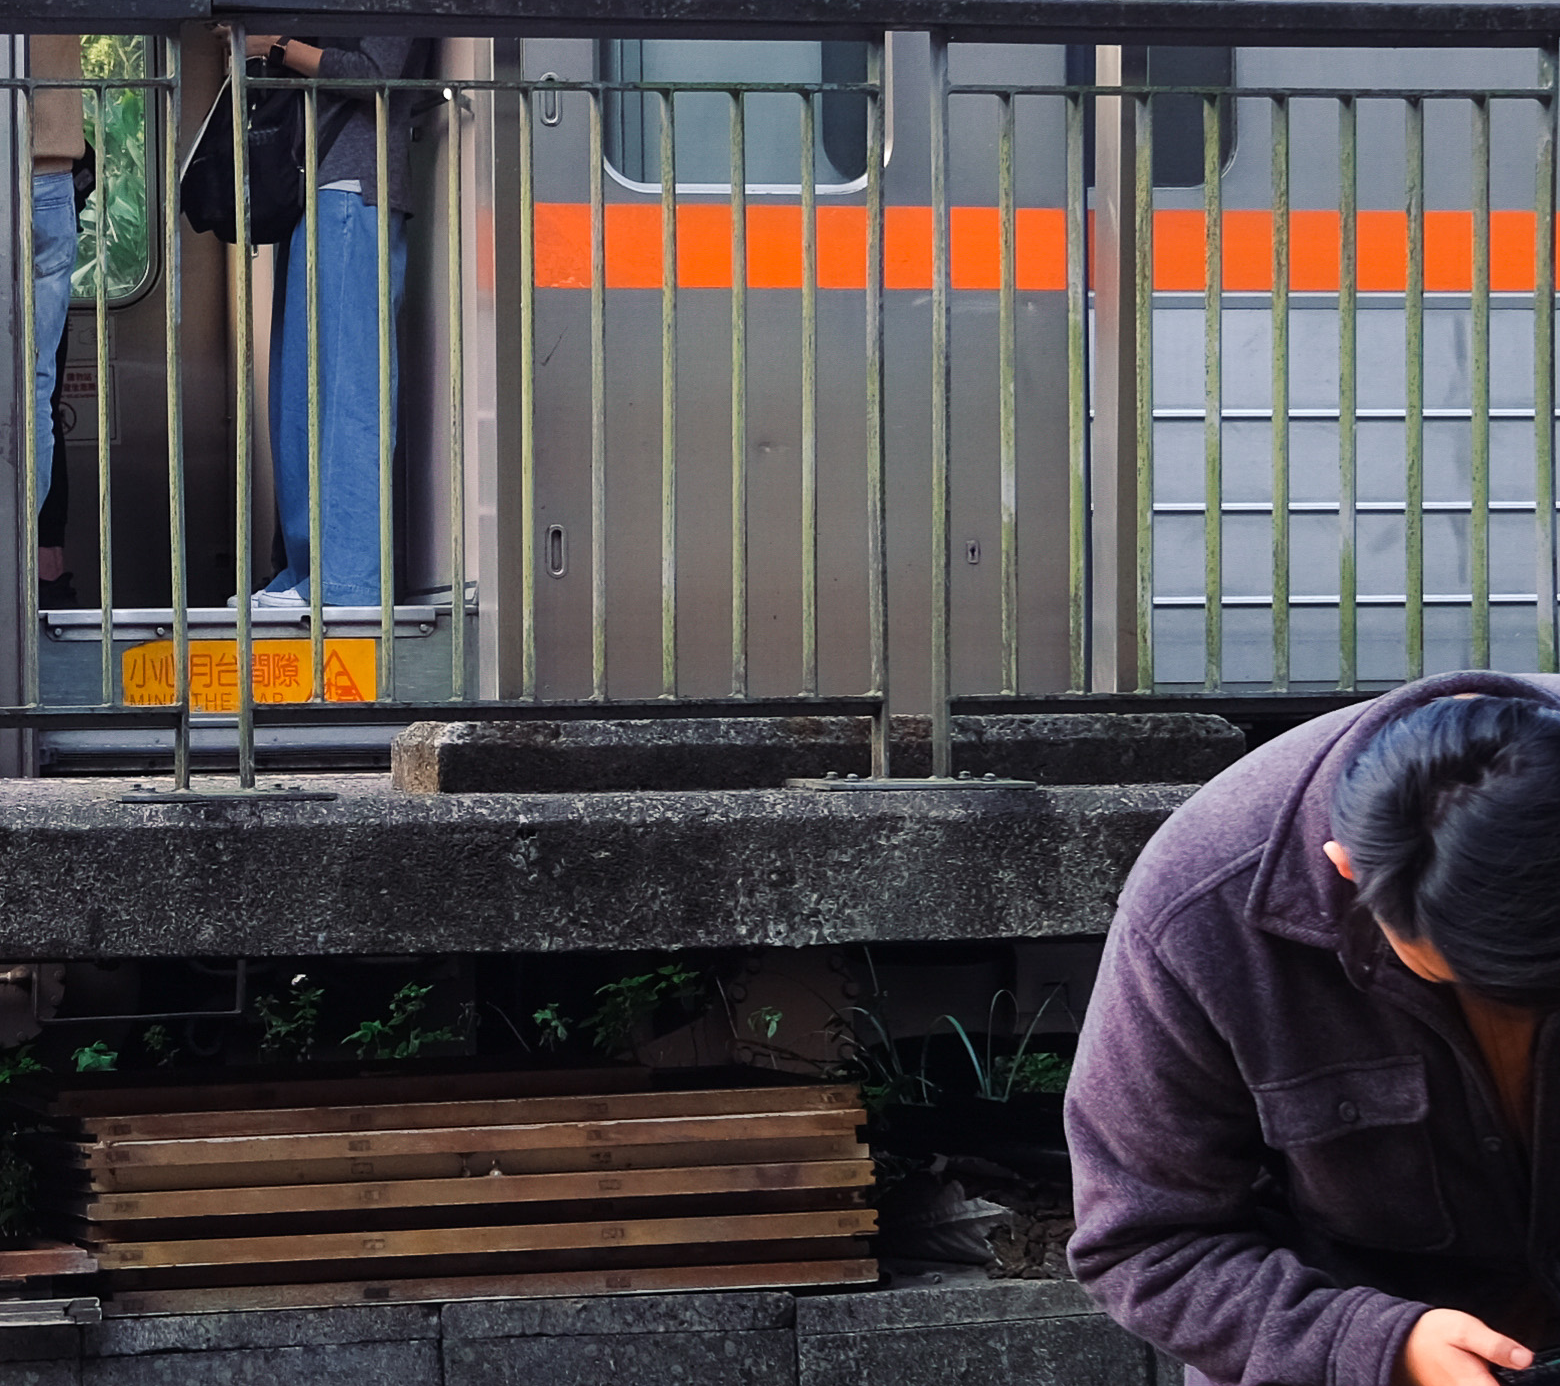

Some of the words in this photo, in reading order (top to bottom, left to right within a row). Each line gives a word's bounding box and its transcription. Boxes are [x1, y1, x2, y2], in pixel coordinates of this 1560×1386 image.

[129, 652, 301, 689] 小心月台間隙
[190, 692, 234, 711] THE
